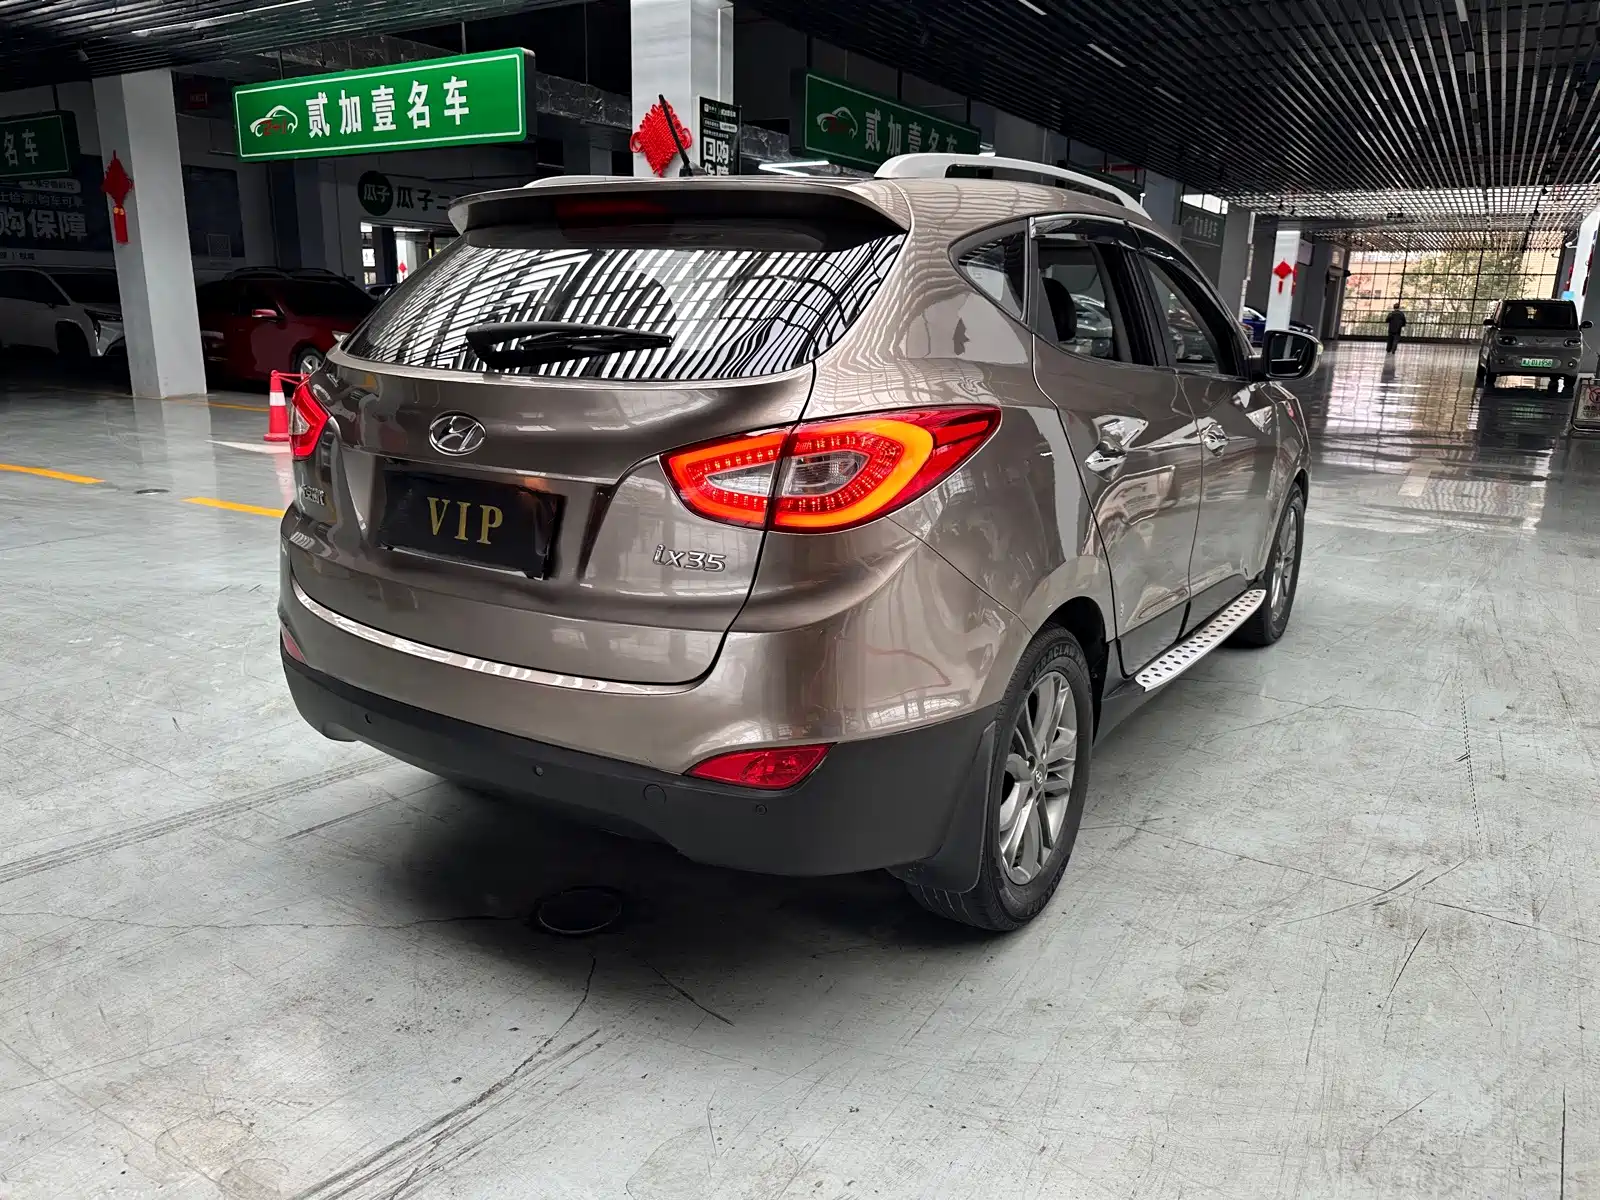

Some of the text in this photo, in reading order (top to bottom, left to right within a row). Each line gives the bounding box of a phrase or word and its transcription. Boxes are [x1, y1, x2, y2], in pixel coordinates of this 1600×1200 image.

[305, 75, 470, 138] 贰加壹名车
[3, 127, 40, 167] 名车
[703, 136, 729, 165] 回购
[363, 183, 391, 203] 瓜子
[426, 496, 504, 545] VIP
[652, 543, 726, 572] ix35
